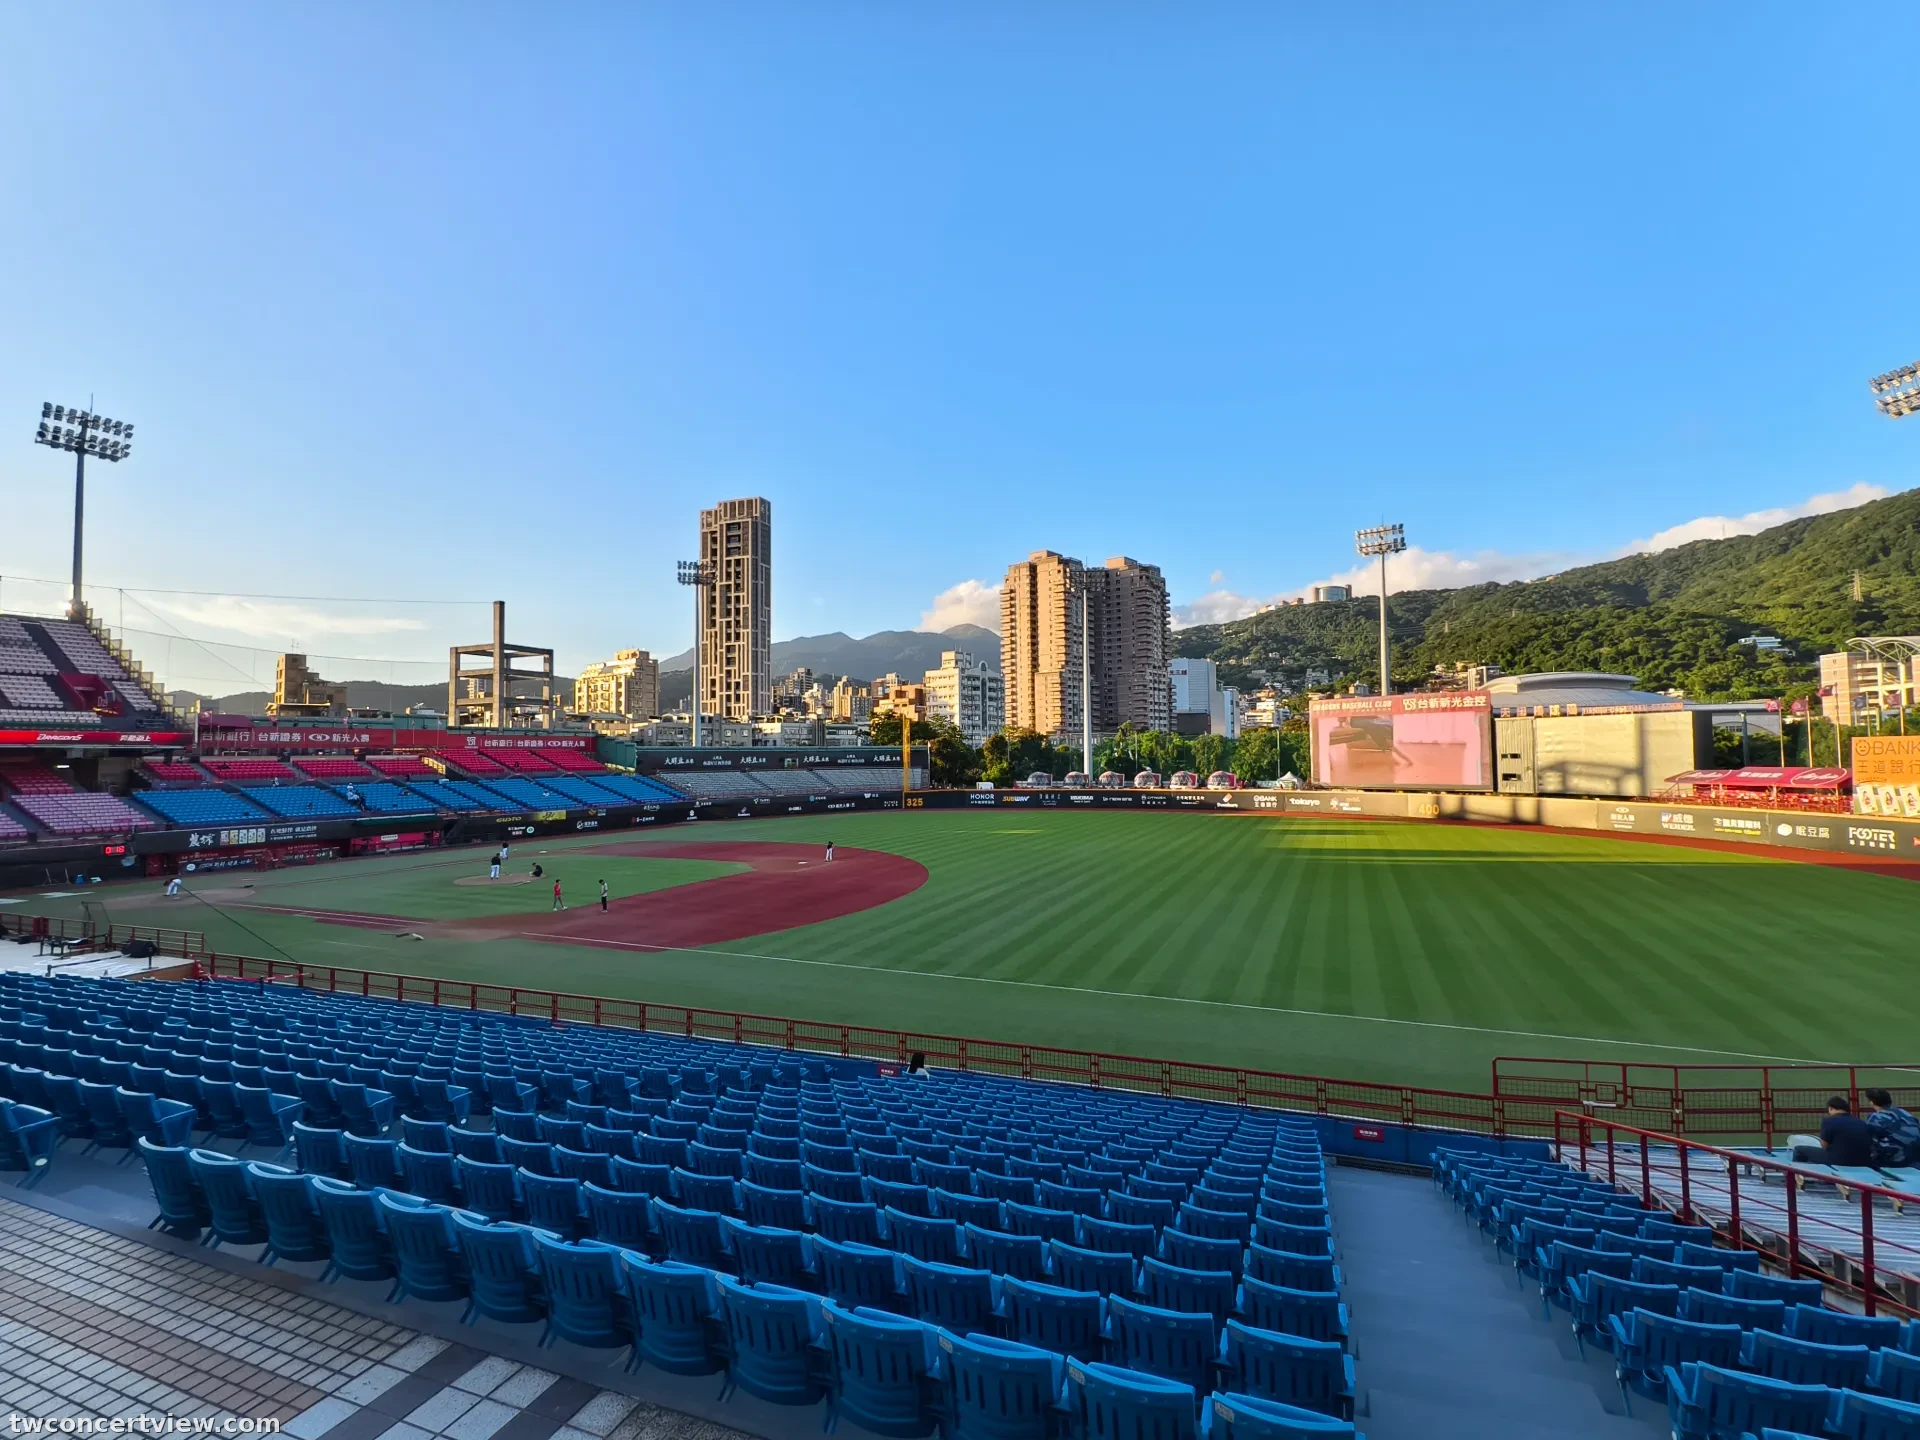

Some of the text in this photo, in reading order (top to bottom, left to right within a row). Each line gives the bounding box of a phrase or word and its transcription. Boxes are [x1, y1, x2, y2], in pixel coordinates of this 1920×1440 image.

[1374, 699, 1392, 708] CLUB
[1417, 695, 1487, 709] 台新新光金控
[36, 733, 84, 741] DRAGONS
[202, 731, 370, 743] 台新銀行 台新證券 新光人壽
[1857, 760, 1920, 774] 王道銀行
[906, 797, 924, 807] 325
[1289, 797, 1320, 807] tokuyo
[1418, 803, 1440, 815] 400
[1795, 825, 1830, 838] 眠豆腐
[1848, 826, 1896, 842] FOOTER
